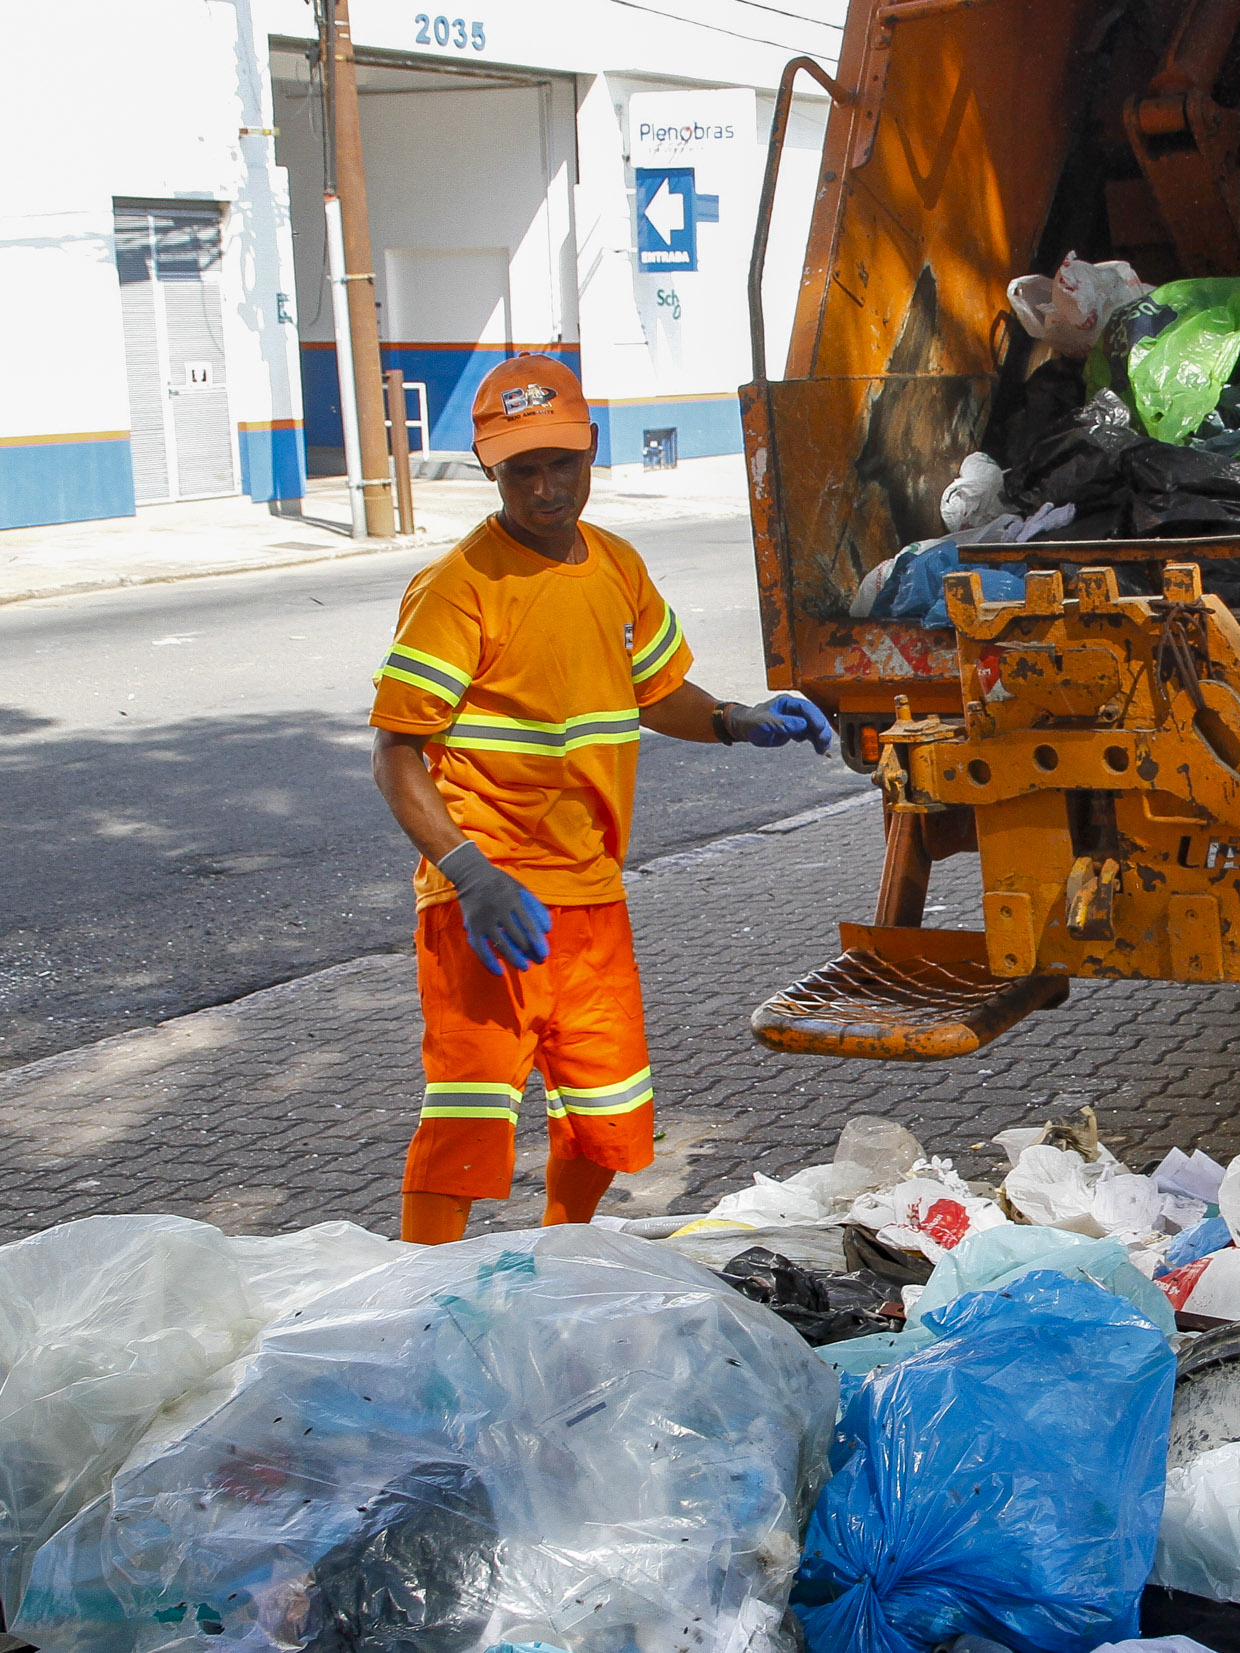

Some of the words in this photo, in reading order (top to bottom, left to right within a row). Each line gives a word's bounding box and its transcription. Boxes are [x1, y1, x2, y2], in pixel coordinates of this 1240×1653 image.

[415, 13, 486, 51] 2035
[640, 122, 734, 142] Plenobras
[641, 250, 690, 264] ENTRADA
